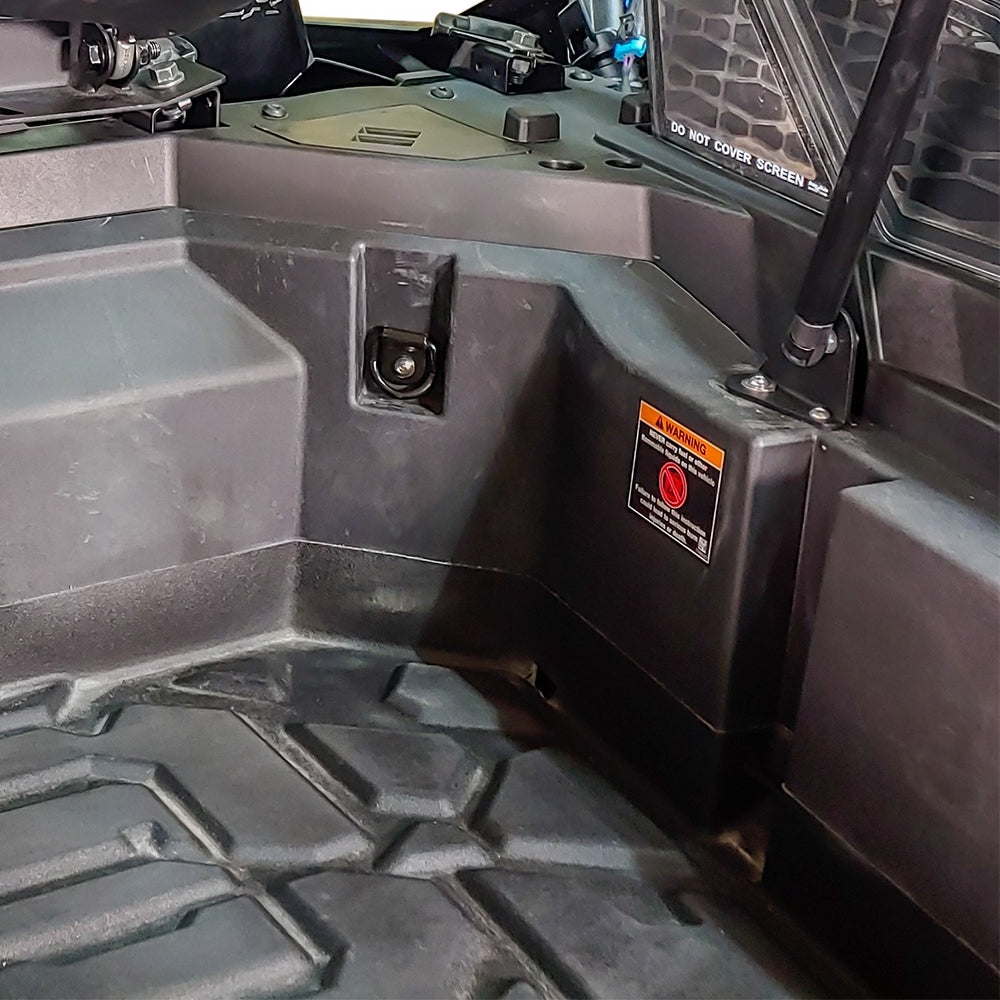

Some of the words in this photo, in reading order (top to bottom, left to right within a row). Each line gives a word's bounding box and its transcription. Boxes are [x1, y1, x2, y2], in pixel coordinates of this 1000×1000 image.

[671, 121, 685, 136] DO
[688, 130, 710, 147] NOT
[714, 141, 752, 165] COVER
[756, 158, 805, 188] SCREEN
[665, 421, 707, 455] WARNING
[635, 483, 650, 499] Failure
